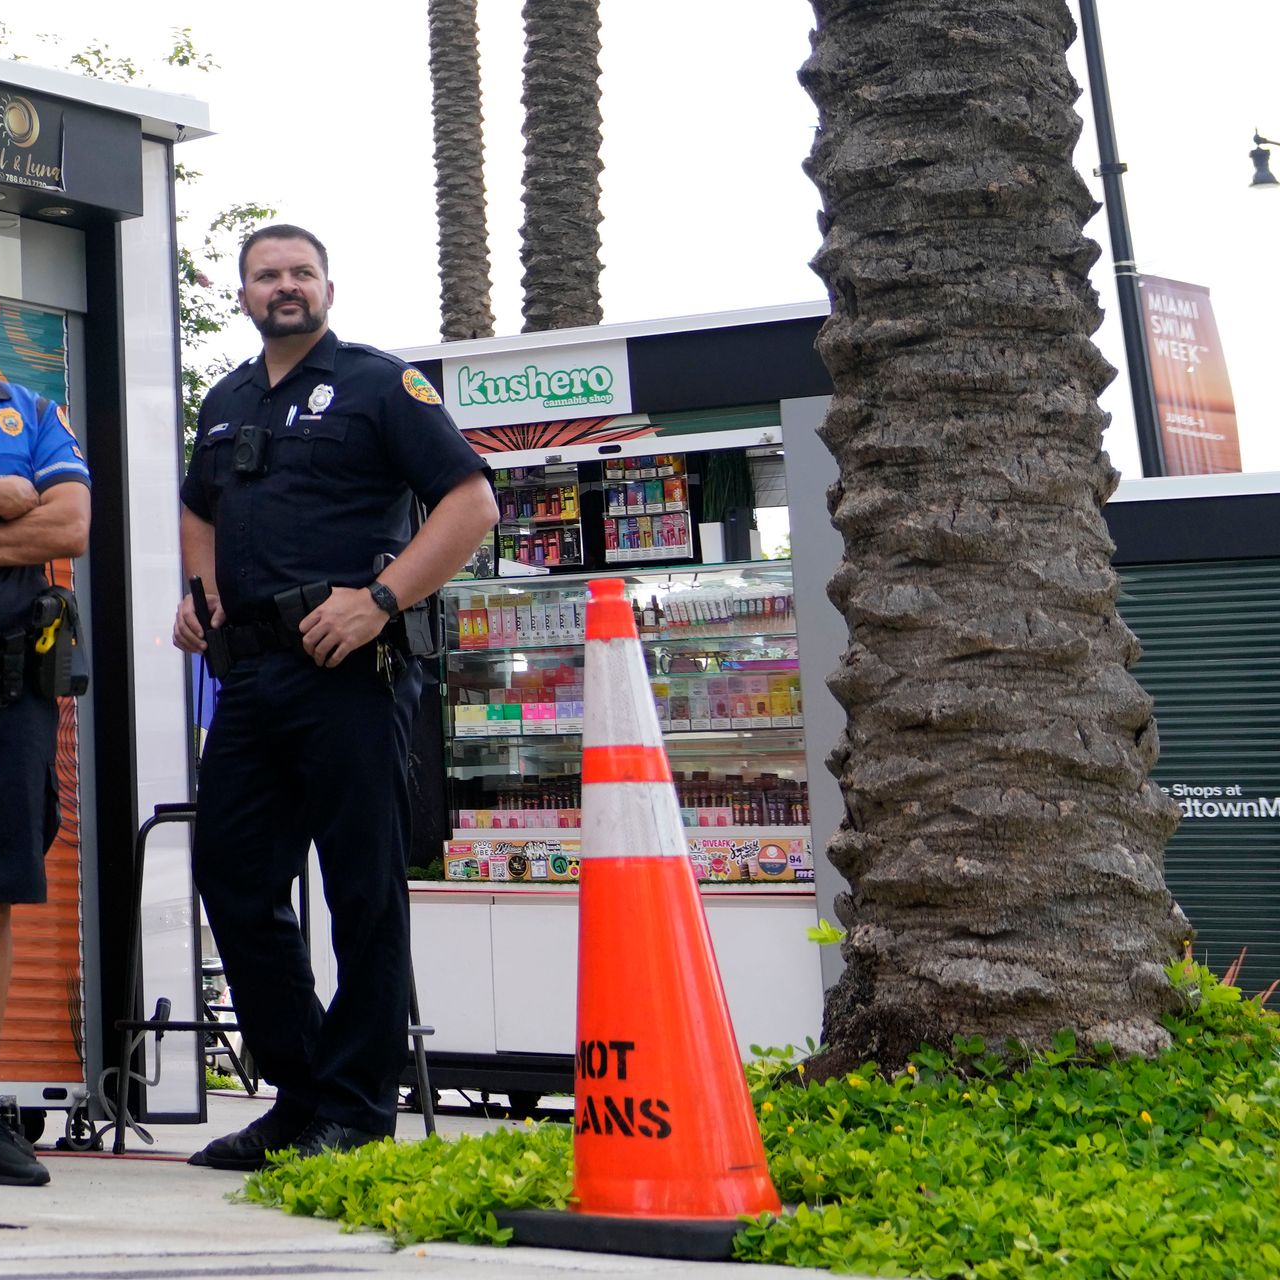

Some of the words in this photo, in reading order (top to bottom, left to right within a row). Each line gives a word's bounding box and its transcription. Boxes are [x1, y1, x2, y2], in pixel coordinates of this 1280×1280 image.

[13, 154, 21, 171] &
[25, 153, 61, 181] Luna
[1148, 292, 1200, 319] MIAMI
[1150, 315, 1196, 340] SWIM
[458, 365, 613, 407] Kushero
[544, 396, 587, 408] cannabis
[589, 394, 613, 405] shop
[1172, 784, 1223, 799] Shops
[1225, 784, 1242, 796] at
[1178, 797, 1280, 818] dtownM
[691, 854, 708, 862] ana
[789, 855, 802, 864] 94
[576, 1096, 672, 1139] ANS
